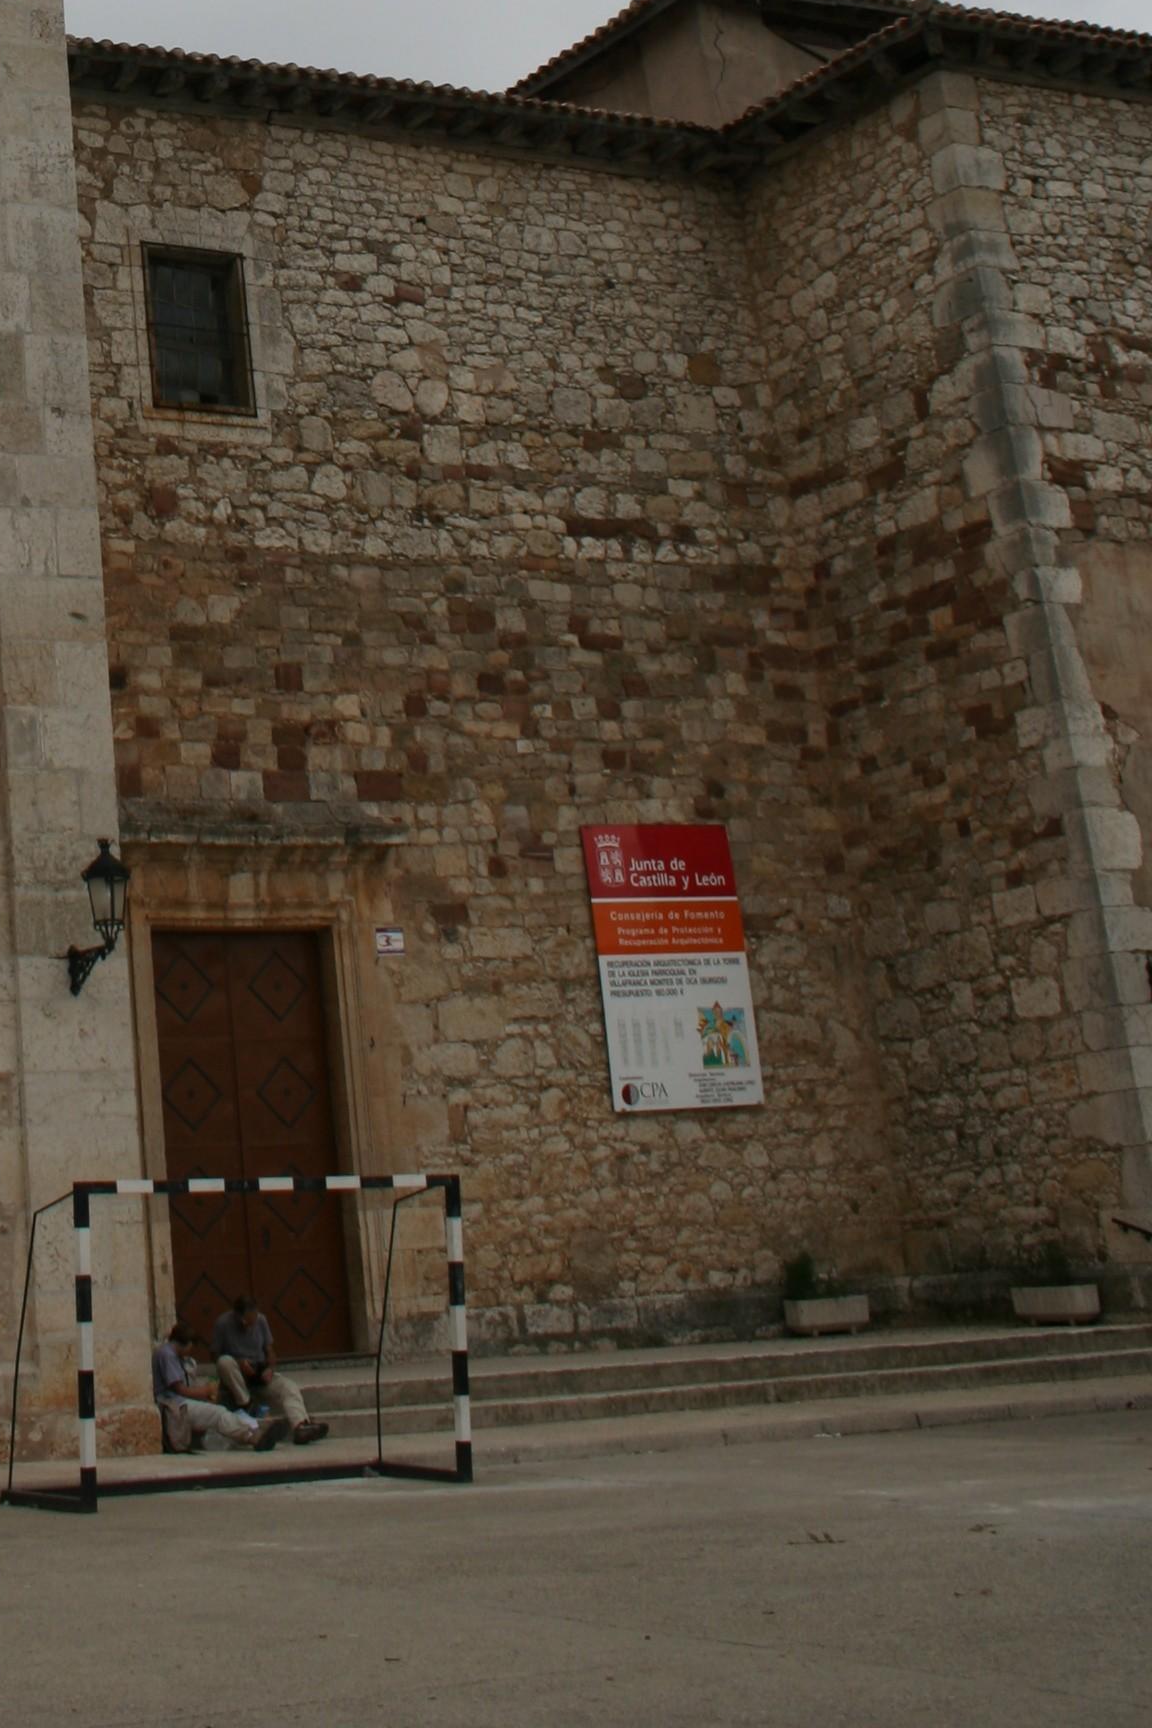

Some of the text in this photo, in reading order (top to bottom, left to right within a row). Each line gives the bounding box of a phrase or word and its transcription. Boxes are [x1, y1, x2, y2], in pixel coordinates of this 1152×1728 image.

[629, 857, 686, 871] Junta de
[630, 872, 726, 890] Castilla y León
[610, 910, 725, 922] Consejería de Fomento
[617, 927, 655, 937] Programa
[659, 927, 668, 935] de
[704, 957, 712, 965] DE
[608, 970, 616, 978] DE
[640, 1082, 668, 1098] CPA
